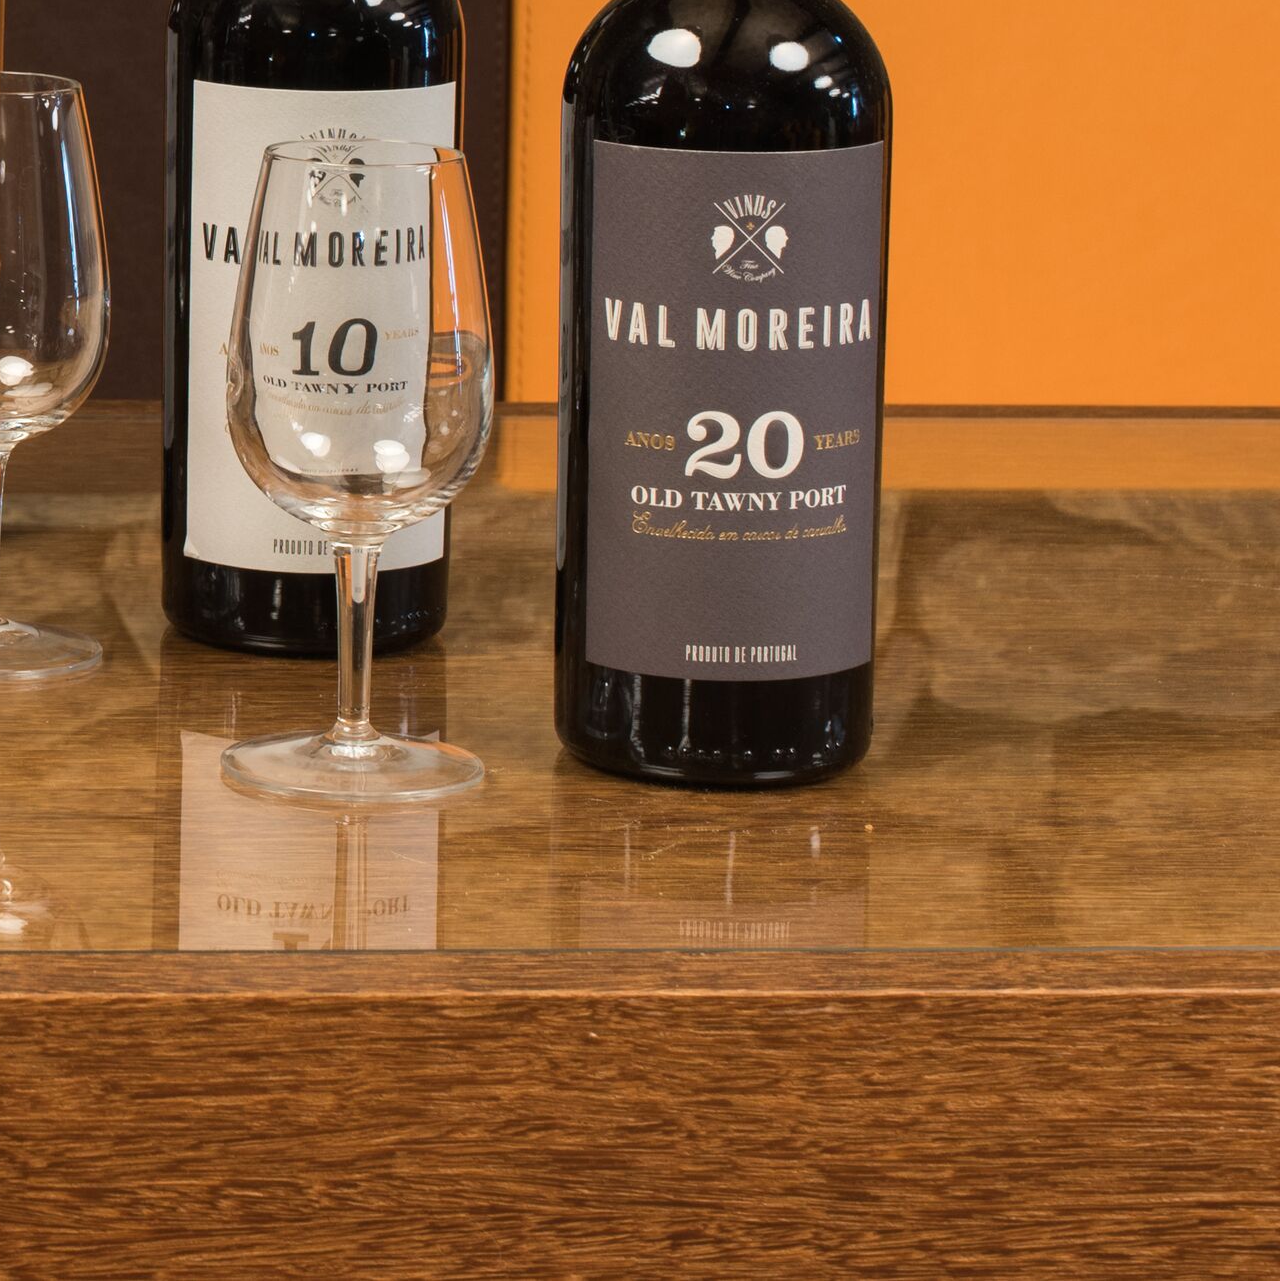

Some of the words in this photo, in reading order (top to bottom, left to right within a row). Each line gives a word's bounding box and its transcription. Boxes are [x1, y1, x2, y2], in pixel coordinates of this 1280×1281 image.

[723, 194, 776, 219] VINUS
[294, 224, 425, 268] MOREIRA
[605, 297, 675, 349] VAL
[696, 299, 871, 352] MOREIRA
[292, 318, 378, 376] 10
[263, 375, 287, 389] OLD
[291, 382, 359, 395] TAWNY
[366, 380, 409, 393] PORT
[625, 429, 676, 451] ANOS
[685, 410, 805, 479] 20
[814, 428, 861, 450] YEARS
[631, 485, 683, 509] OLD
[691, 490, 781, 511] TAWNY
[790, 484, 847, 508] PORT
[273, 539, 313, 555] PRODUTO
[317, 541, 328, 555] DE
[685, 644, 731, 663] PRODUTO
[735, 645, 746, 663] DE
[751, 643, 797, 663] PORTUGAL
